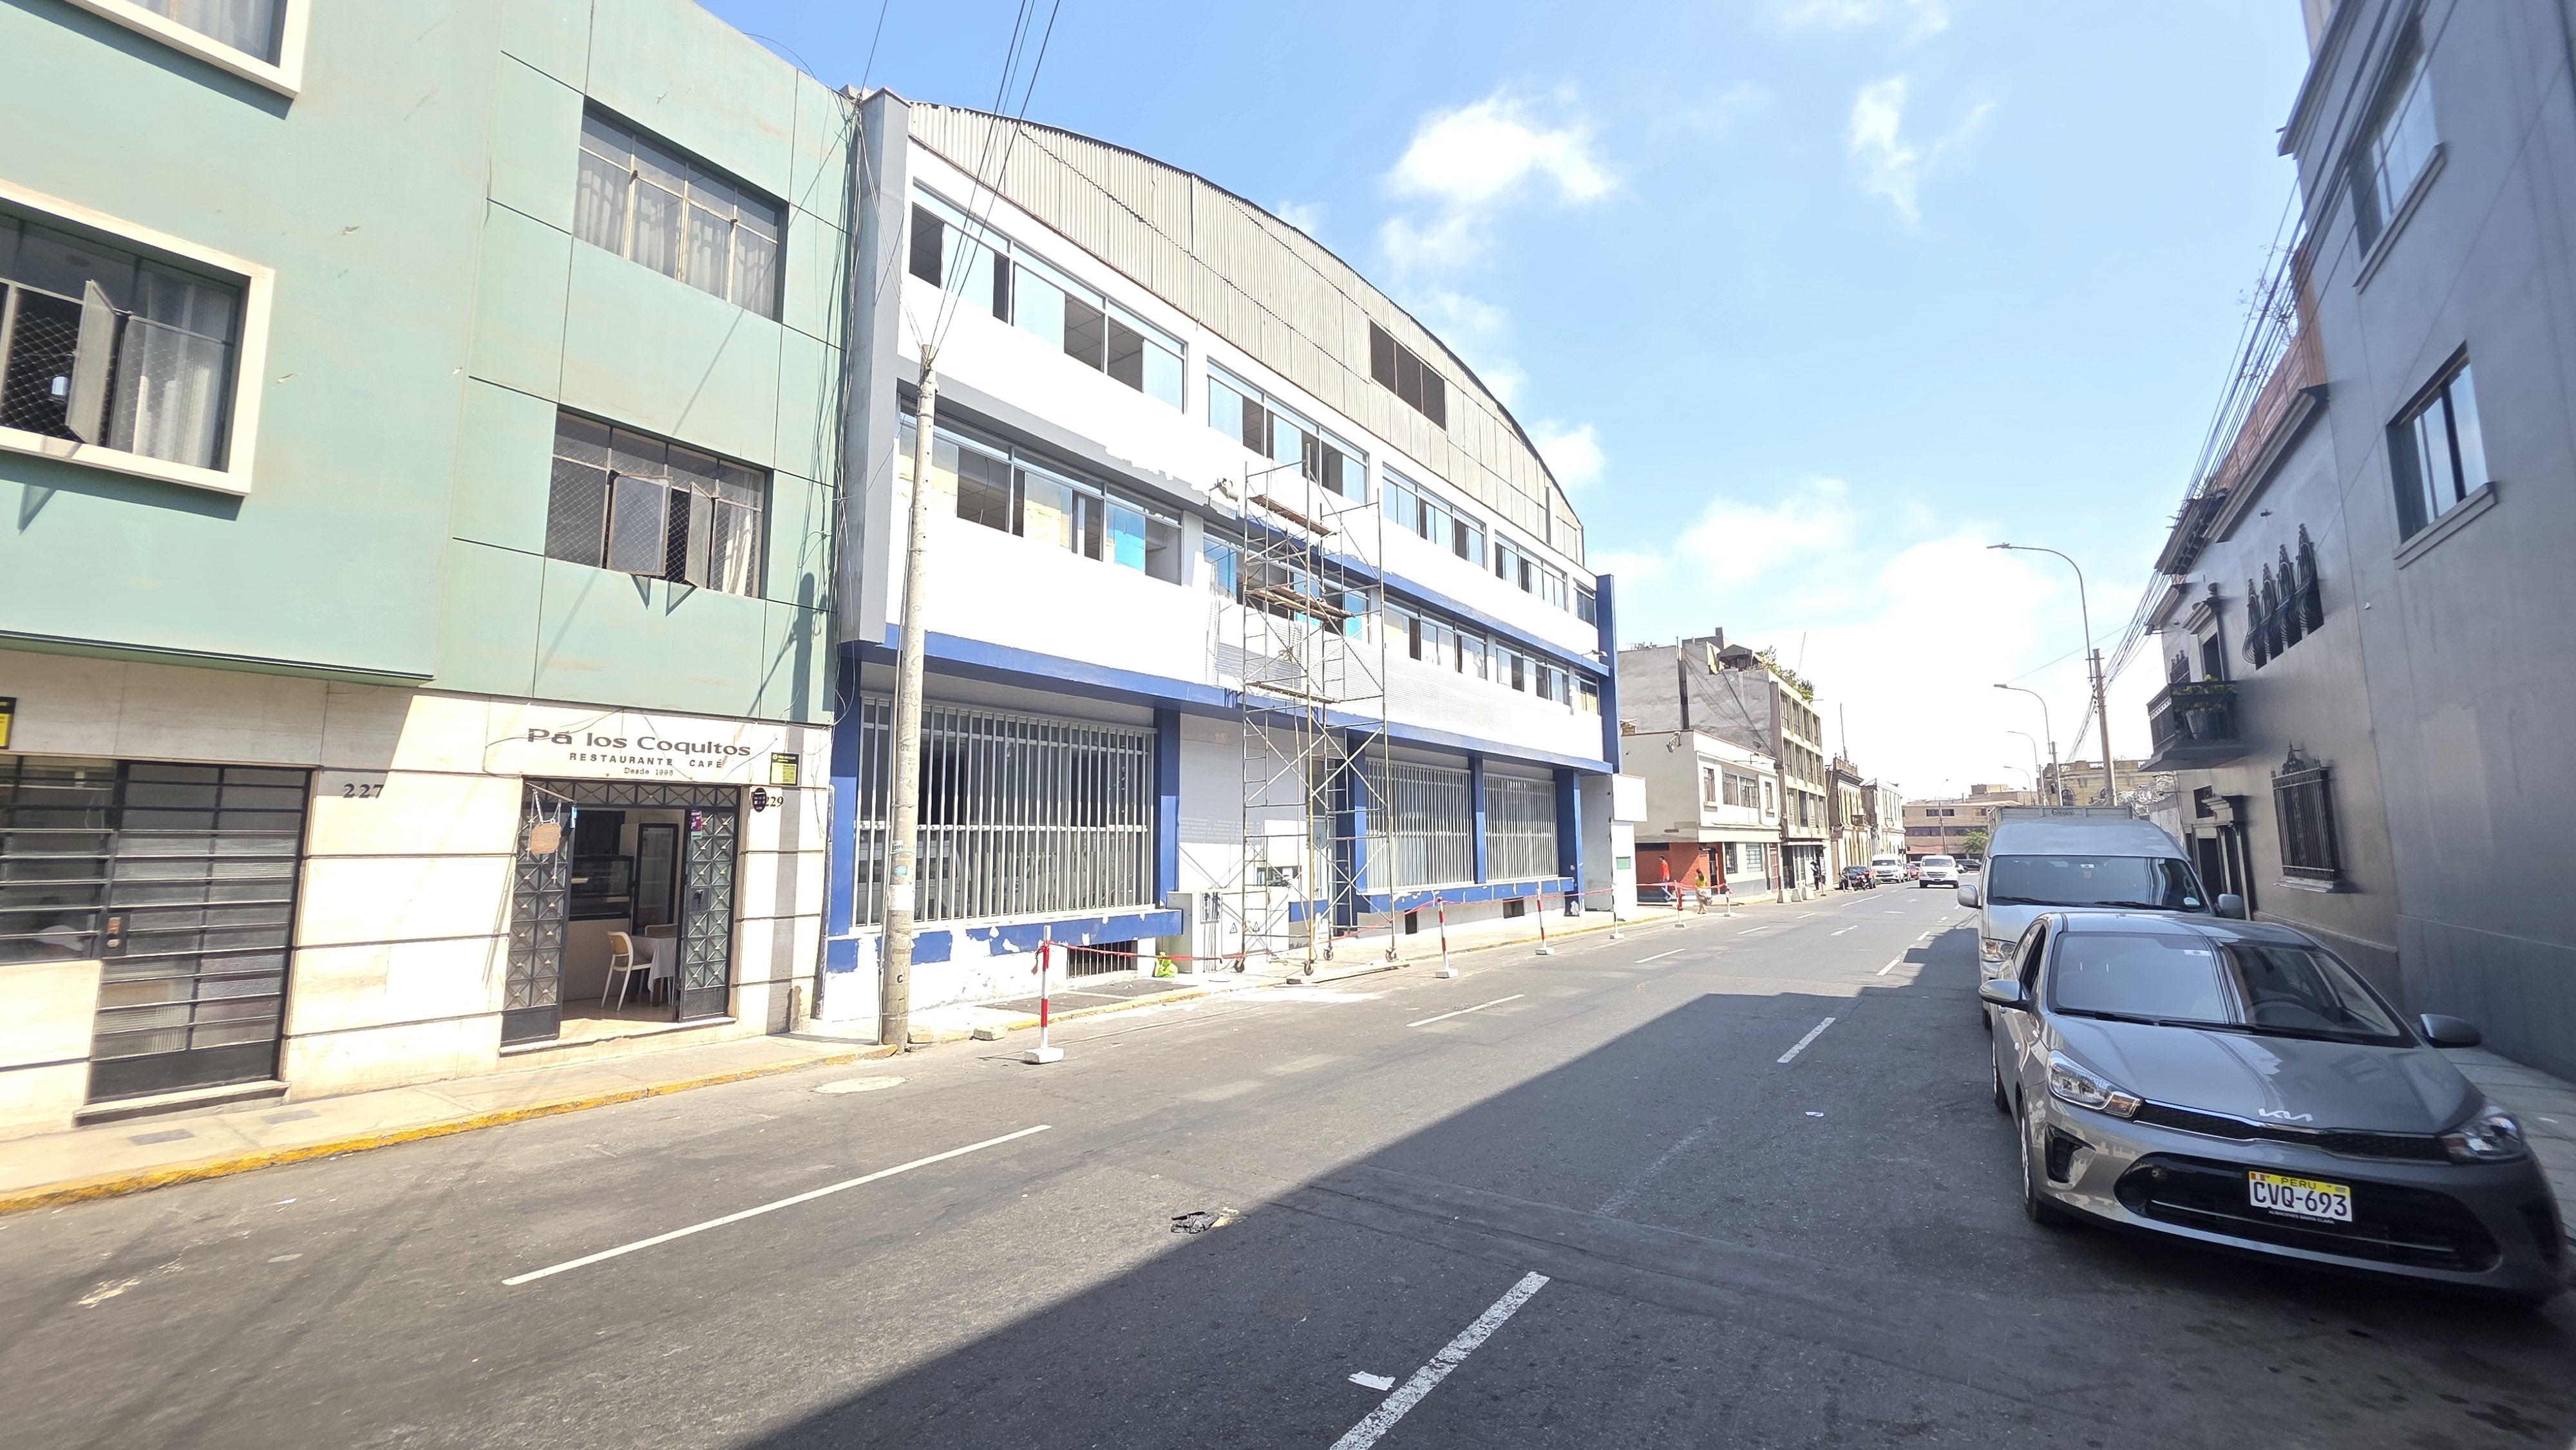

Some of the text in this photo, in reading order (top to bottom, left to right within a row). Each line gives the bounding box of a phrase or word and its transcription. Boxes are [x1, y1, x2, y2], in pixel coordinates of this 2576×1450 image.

[587, 733, 627, 748] los
[637, 737, 750, 756] Coquitos
[569, 753, 722, 768] RESTAURANTE CAFÉ
[343, 783, 384, 798] 227
[2280, 1178, 2316, 1190] PERU
[2253, 1182, 2347, 1216] CVQ-693
